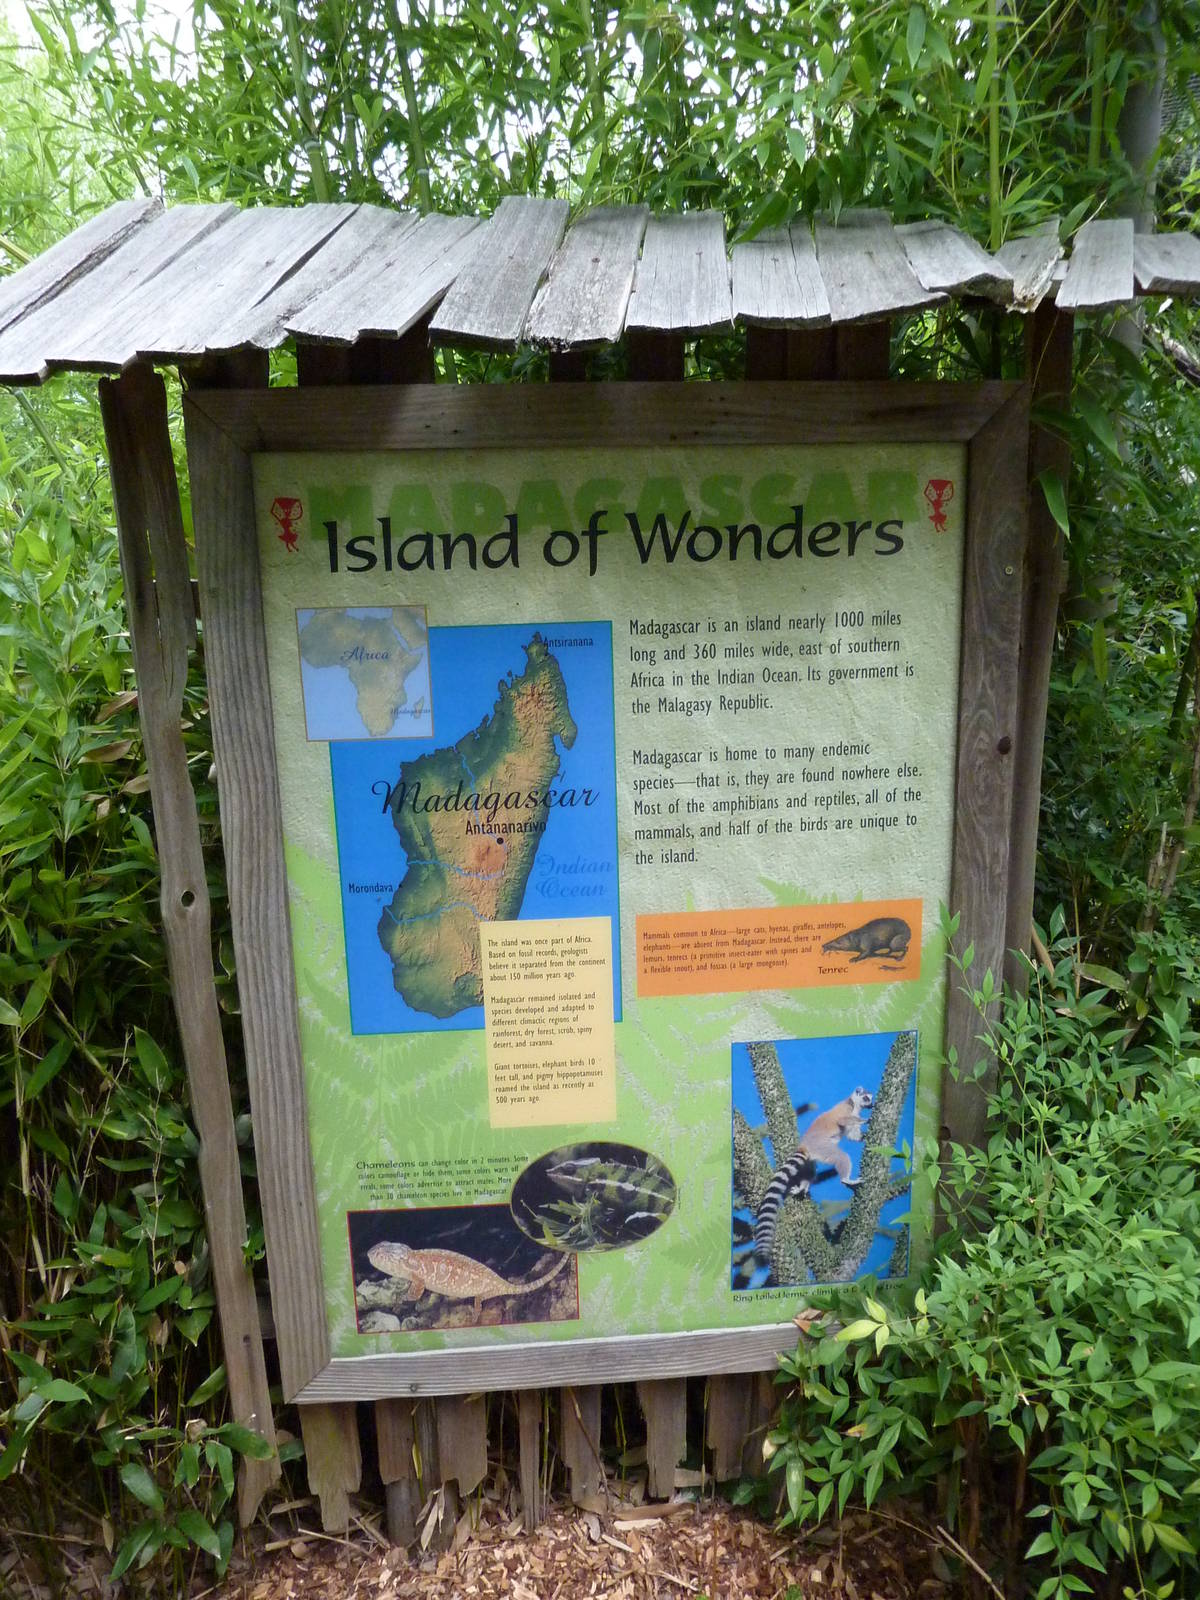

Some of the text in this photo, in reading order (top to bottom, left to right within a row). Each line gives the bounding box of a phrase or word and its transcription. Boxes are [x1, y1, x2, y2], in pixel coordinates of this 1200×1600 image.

[307, 470, 920, 540] MADAGASCAR
[322, 505, 904, 576] Island of Wonders
[630, 611, 901, 638] Madagascar is an island nearly 1000 miles
[543, 636, 593, 648] Antsiranana
[341, 646, 392, 662] Africa
[630, 638, 900, 666] long and 360 miles wide, east of southern
[631, 672, 664, 687] Africa
[673, 671, 683, 686] in
[691, 670, 710, 685] the
[718, 669, 754, 684] Indian
[808, 666, 821, 680] Its
[829, 666, 898, 684] government
[906, 662, 914, 676] is
[632, 694, 773, 716] the Malagasy Republic.
[633, 741, 870, 768] Madagascar is home to many endemic
[727, 772, 739, 787] is,
[746, 771, 769, 789] they
[777, 773, 794, 784] are
[802, 767, 834, 782] found
[842, 766, 890, 780] nowhere
[897, 763, 922, 777] else.
[372, 780, 599, 822] Madagascar
[634, 788, 921, 815] Most of the amphibians and reptiles, all of the
[466, 816, 546, 836] Antananarivo
[635, 814, 917, 839] mammals, and half of the birds are unique to
[636, 848, 698, 864] the island.
[537, 854, 613, 876] Indian
[349, 883, 393, 894] Morondava
[536, 880, 607, 898] Ocean
[551, 938, 563, 947] part
[561, 948, 588, 958] geologists
[519, 960, 547, 970] separated
[818, 966, 848, 975] Tenrec
[546, 973, 561, 981] years
[491, 997, 525, 1005] Madagascar
[492, 1009, 512, 1017] species
[515, 1006, 544, 1015] developed
[562, 1004, 585, 1013] adapted
[548, 1017, 570, 1026] regions
[524, 1029, 534, 1038] dry
[542, 1061, 567, 1070] elephant
[562, 1081, 585, 1090] recently
